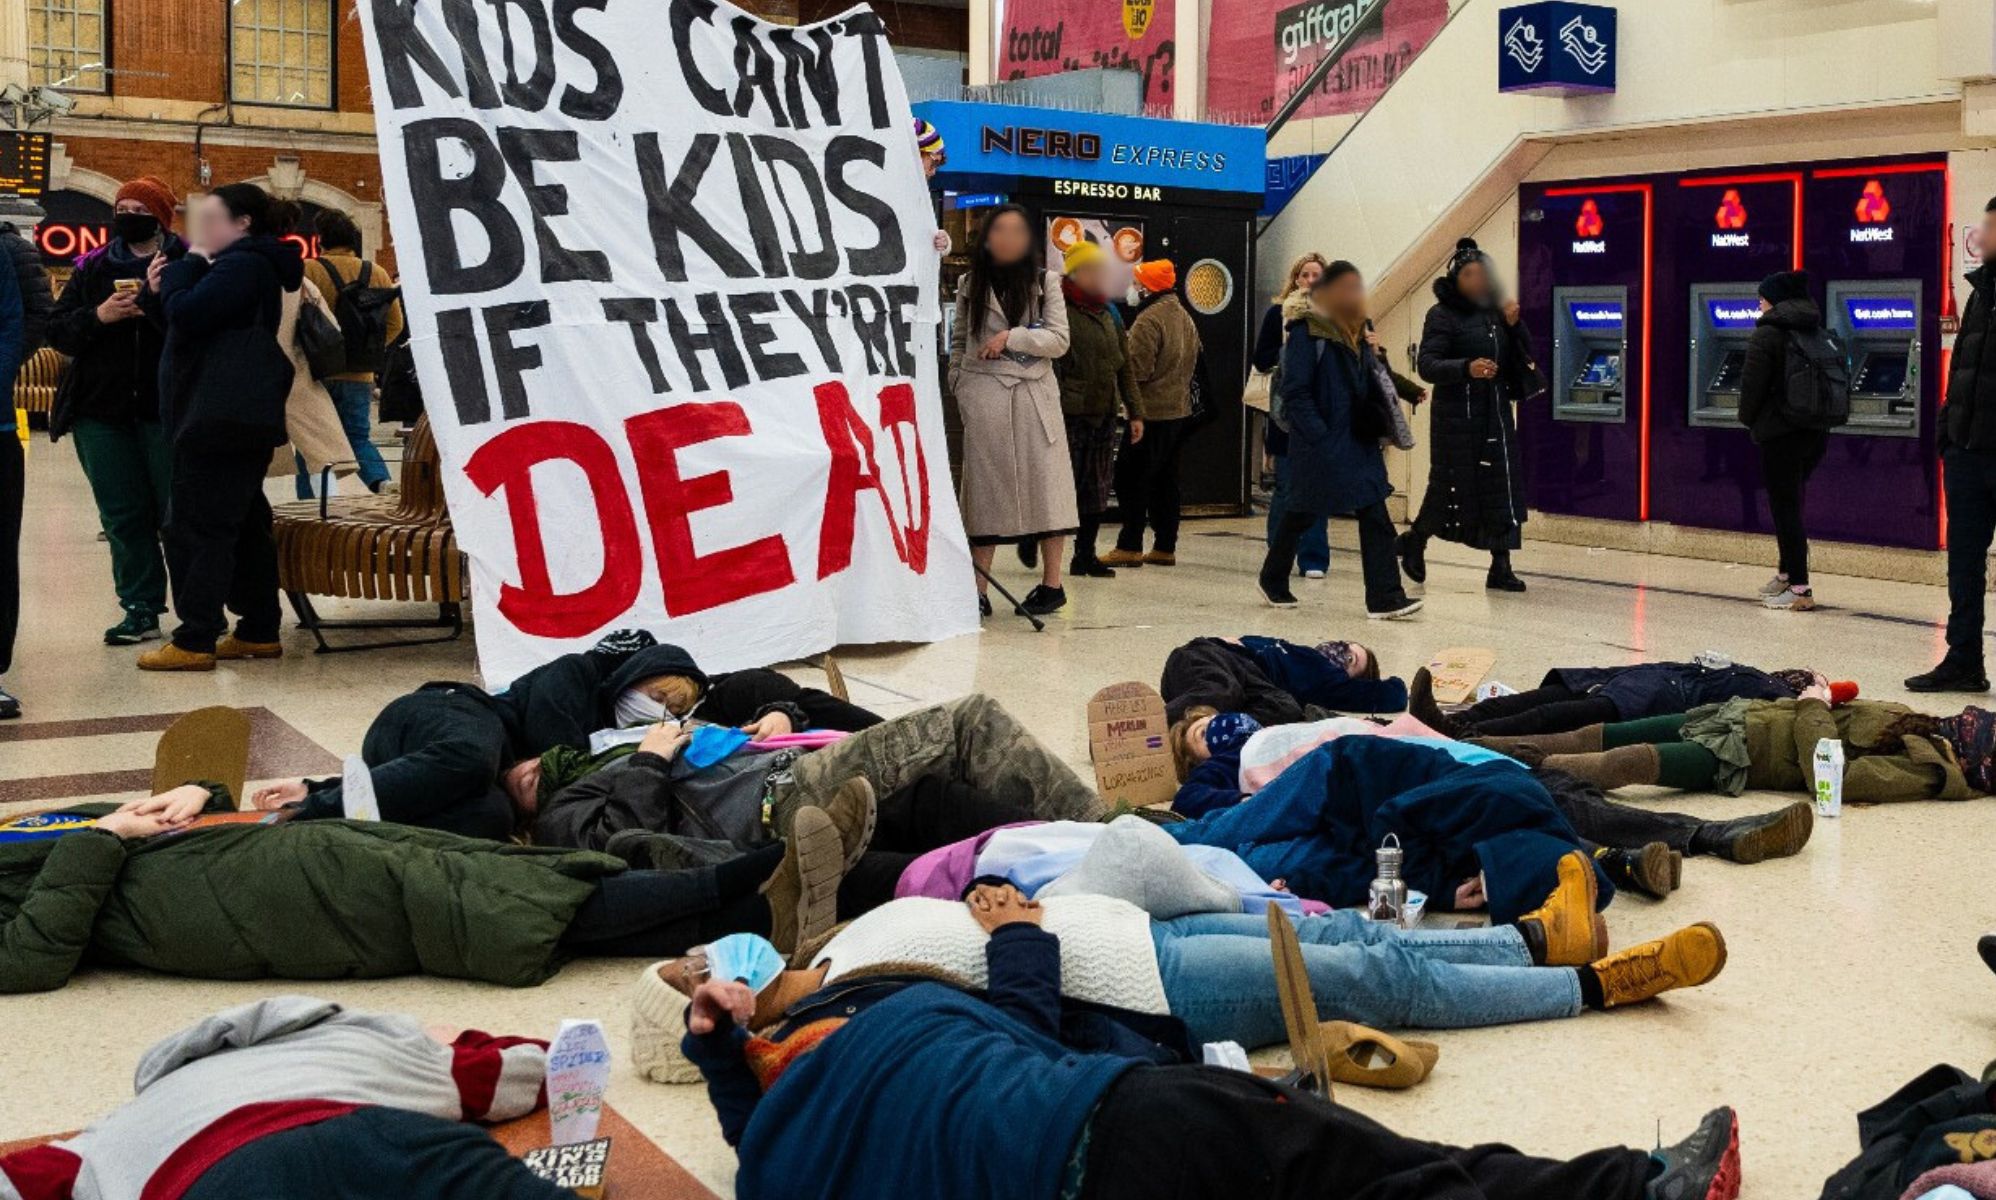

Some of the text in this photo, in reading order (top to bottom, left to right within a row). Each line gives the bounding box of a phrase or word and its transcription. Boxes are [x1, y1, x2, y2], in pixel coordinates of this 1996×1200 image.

[373, 0, 624, 121] KIDS
[669, 0, 892, 130] CAN'T
[1008, 20, 1063, 63] total
[981, 125, 1227, 172] NERO EXPRESS
[401, 118, 907, 296] BE KIDS
[1054, 180, 1161, 201] ESPRESSO BAR
[1712, 234, 1749, 247] NatWest
[1850, 227, 1894, 242] NatWest
[434, 285, 920, 427] IF THEY'RE
[462, 380, 930, 639] DEAD
